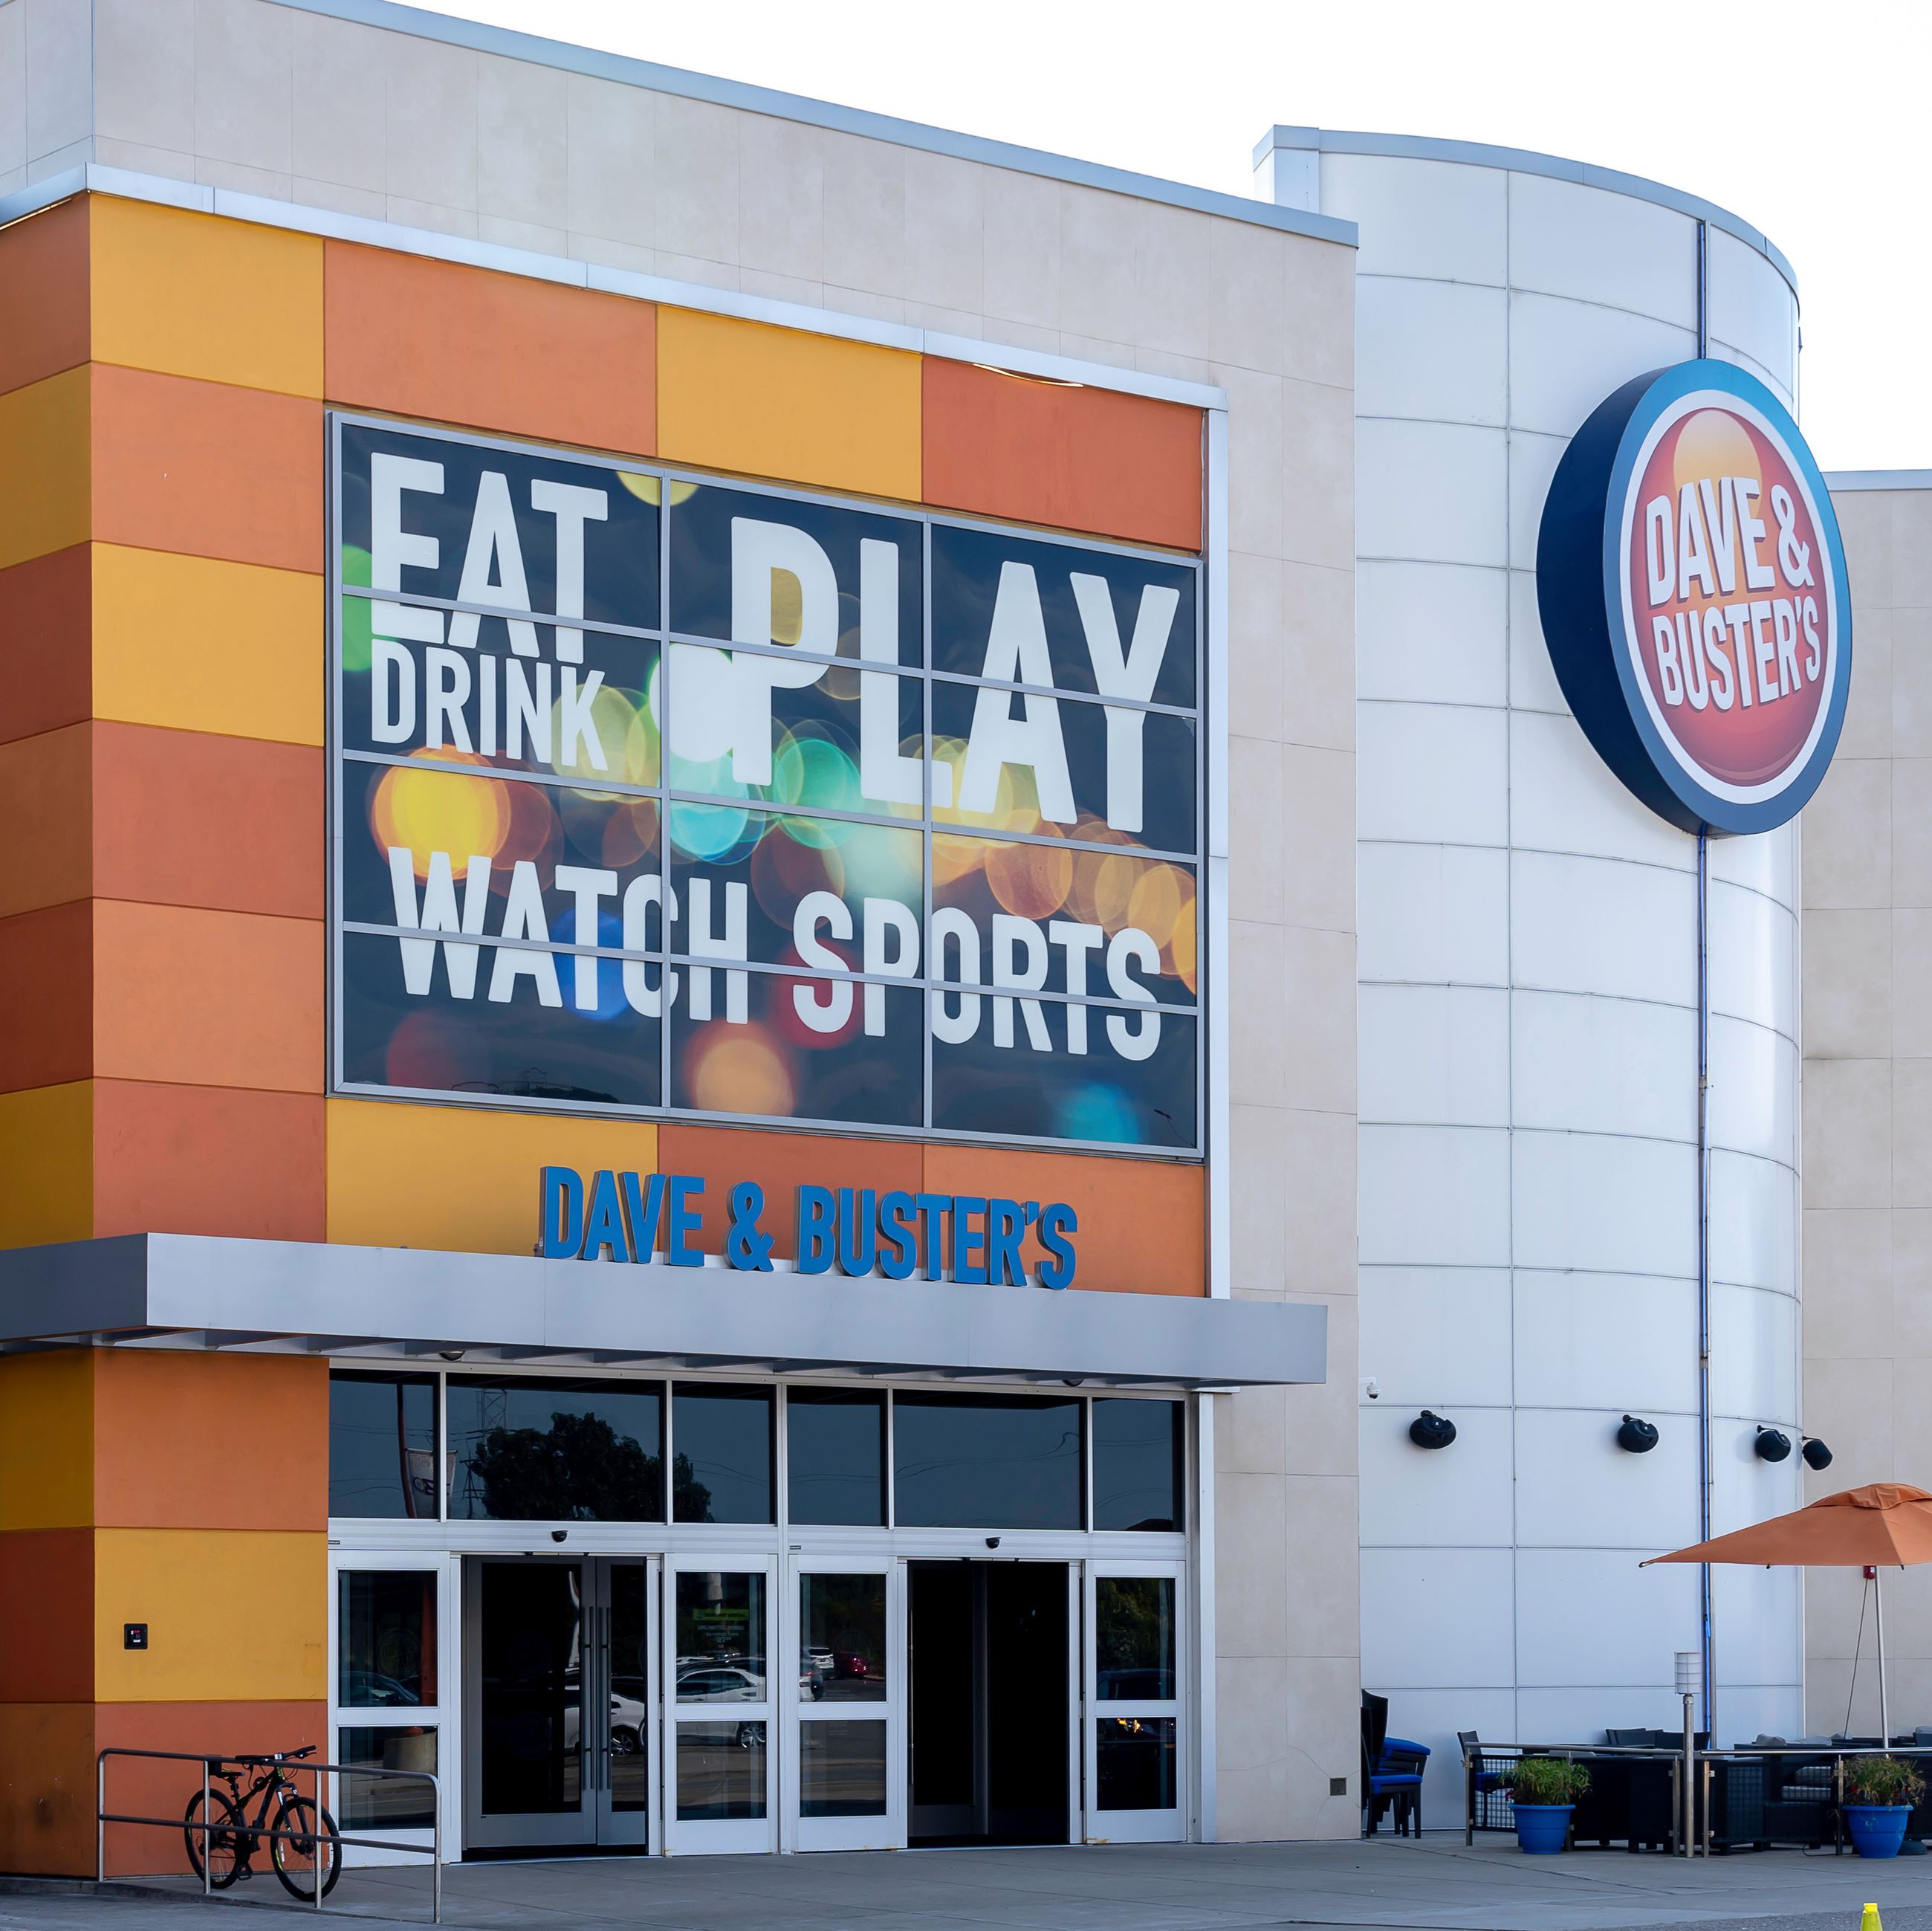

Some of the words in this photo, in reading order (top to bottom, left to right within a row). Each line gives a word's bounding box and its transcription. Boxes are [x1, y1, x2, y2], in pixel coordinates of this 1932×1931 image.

[372, 452, 608, 664] EAT
[1646, 476, 1776, 607] DAVE
[1771, 484, 1815, 589] &
[372, 639, 608, 771] DRINK
[731, 516, 1180, 832] PLAY
[1652, 595, 1821, 713] BUSTER'S
[387, 846, 748, 1024] WATCH
[793, 890, 1161, 1061] SPORTS
[540, 1166, 705, 1267] DAVE
[724, 1181, 775, 1272] &
[794, 1185, 1077, 1290] BUSTER'S
